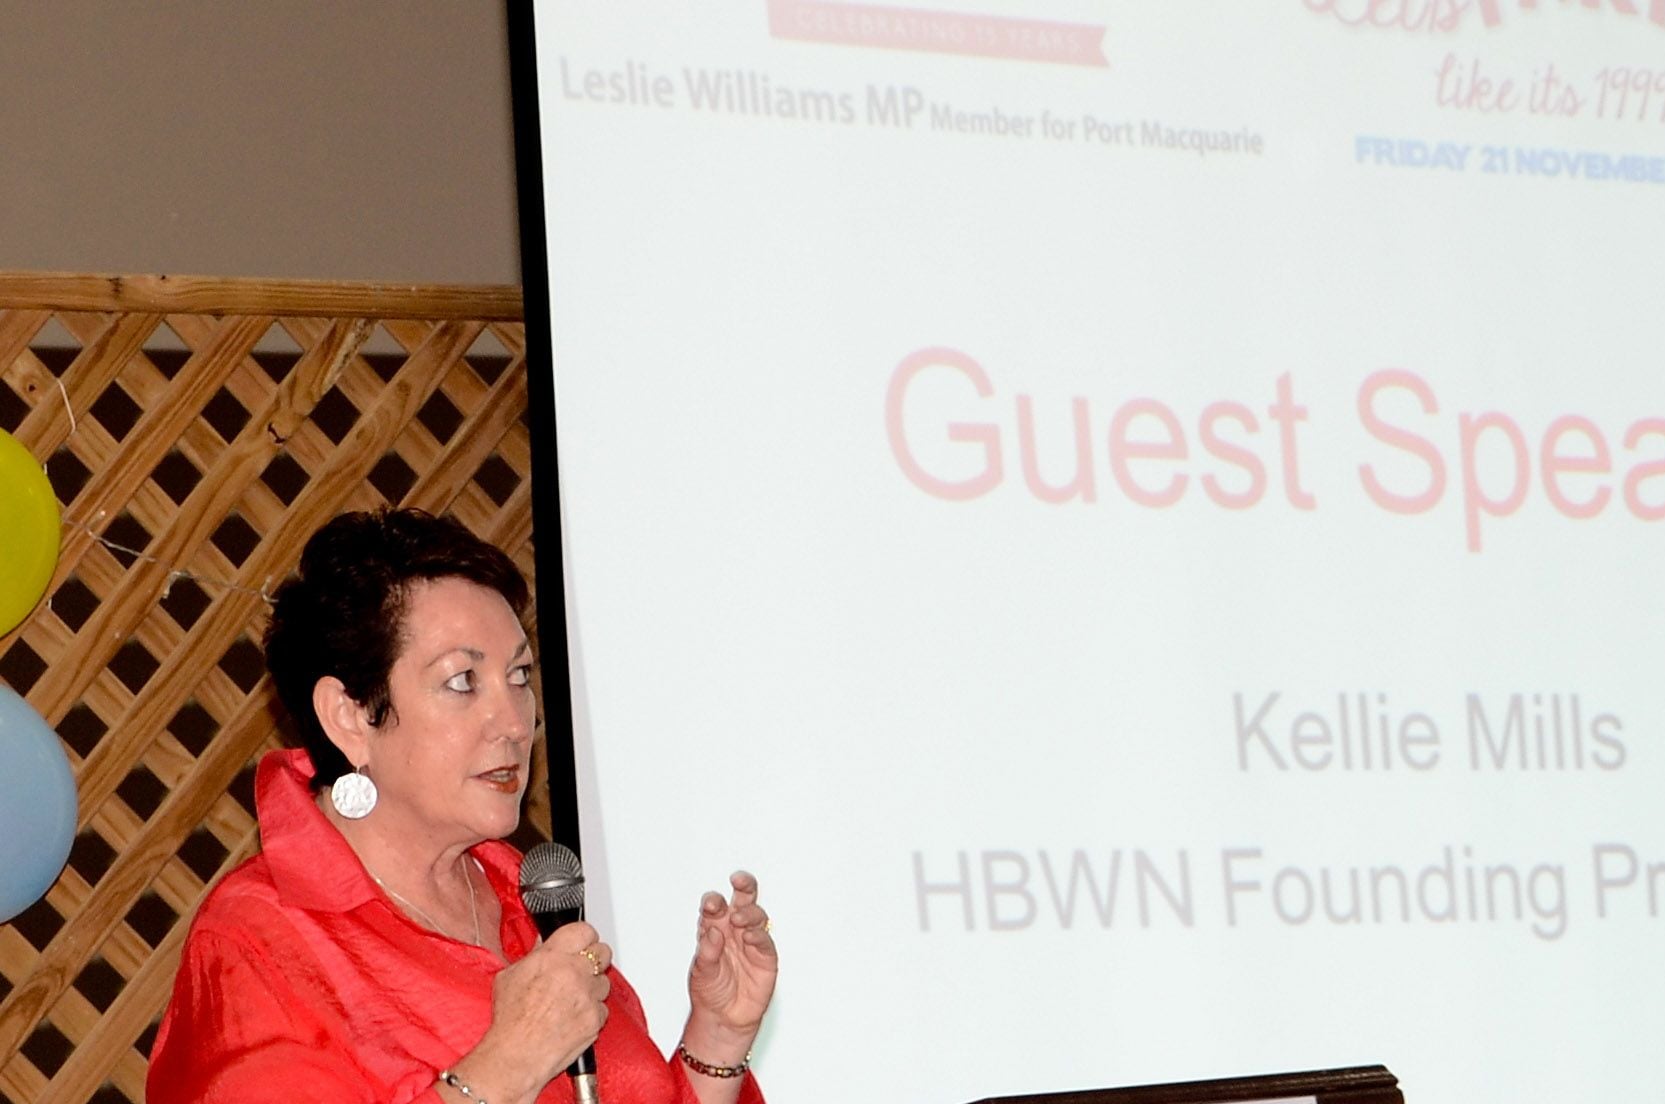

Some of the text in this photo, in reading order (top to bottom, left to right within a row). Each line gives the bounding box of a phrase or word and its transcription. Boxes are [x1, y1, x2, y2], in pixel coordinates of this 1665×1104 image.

[559, 55, 1264, 157] Leslie Williams MP Member for Port Macquarie
[1434, 52, 1518, 113] like
[1354, 135, 1473, 173] FRIDAY
[1480, 145, 1510, 175] 21
[884, 346, 1317, 511] Guest
[1232, 691, 1628, 772] Kellie Mills
[911, 848, 1195, 932] HBWN
[1220, 845, 1569, 942] Founding
